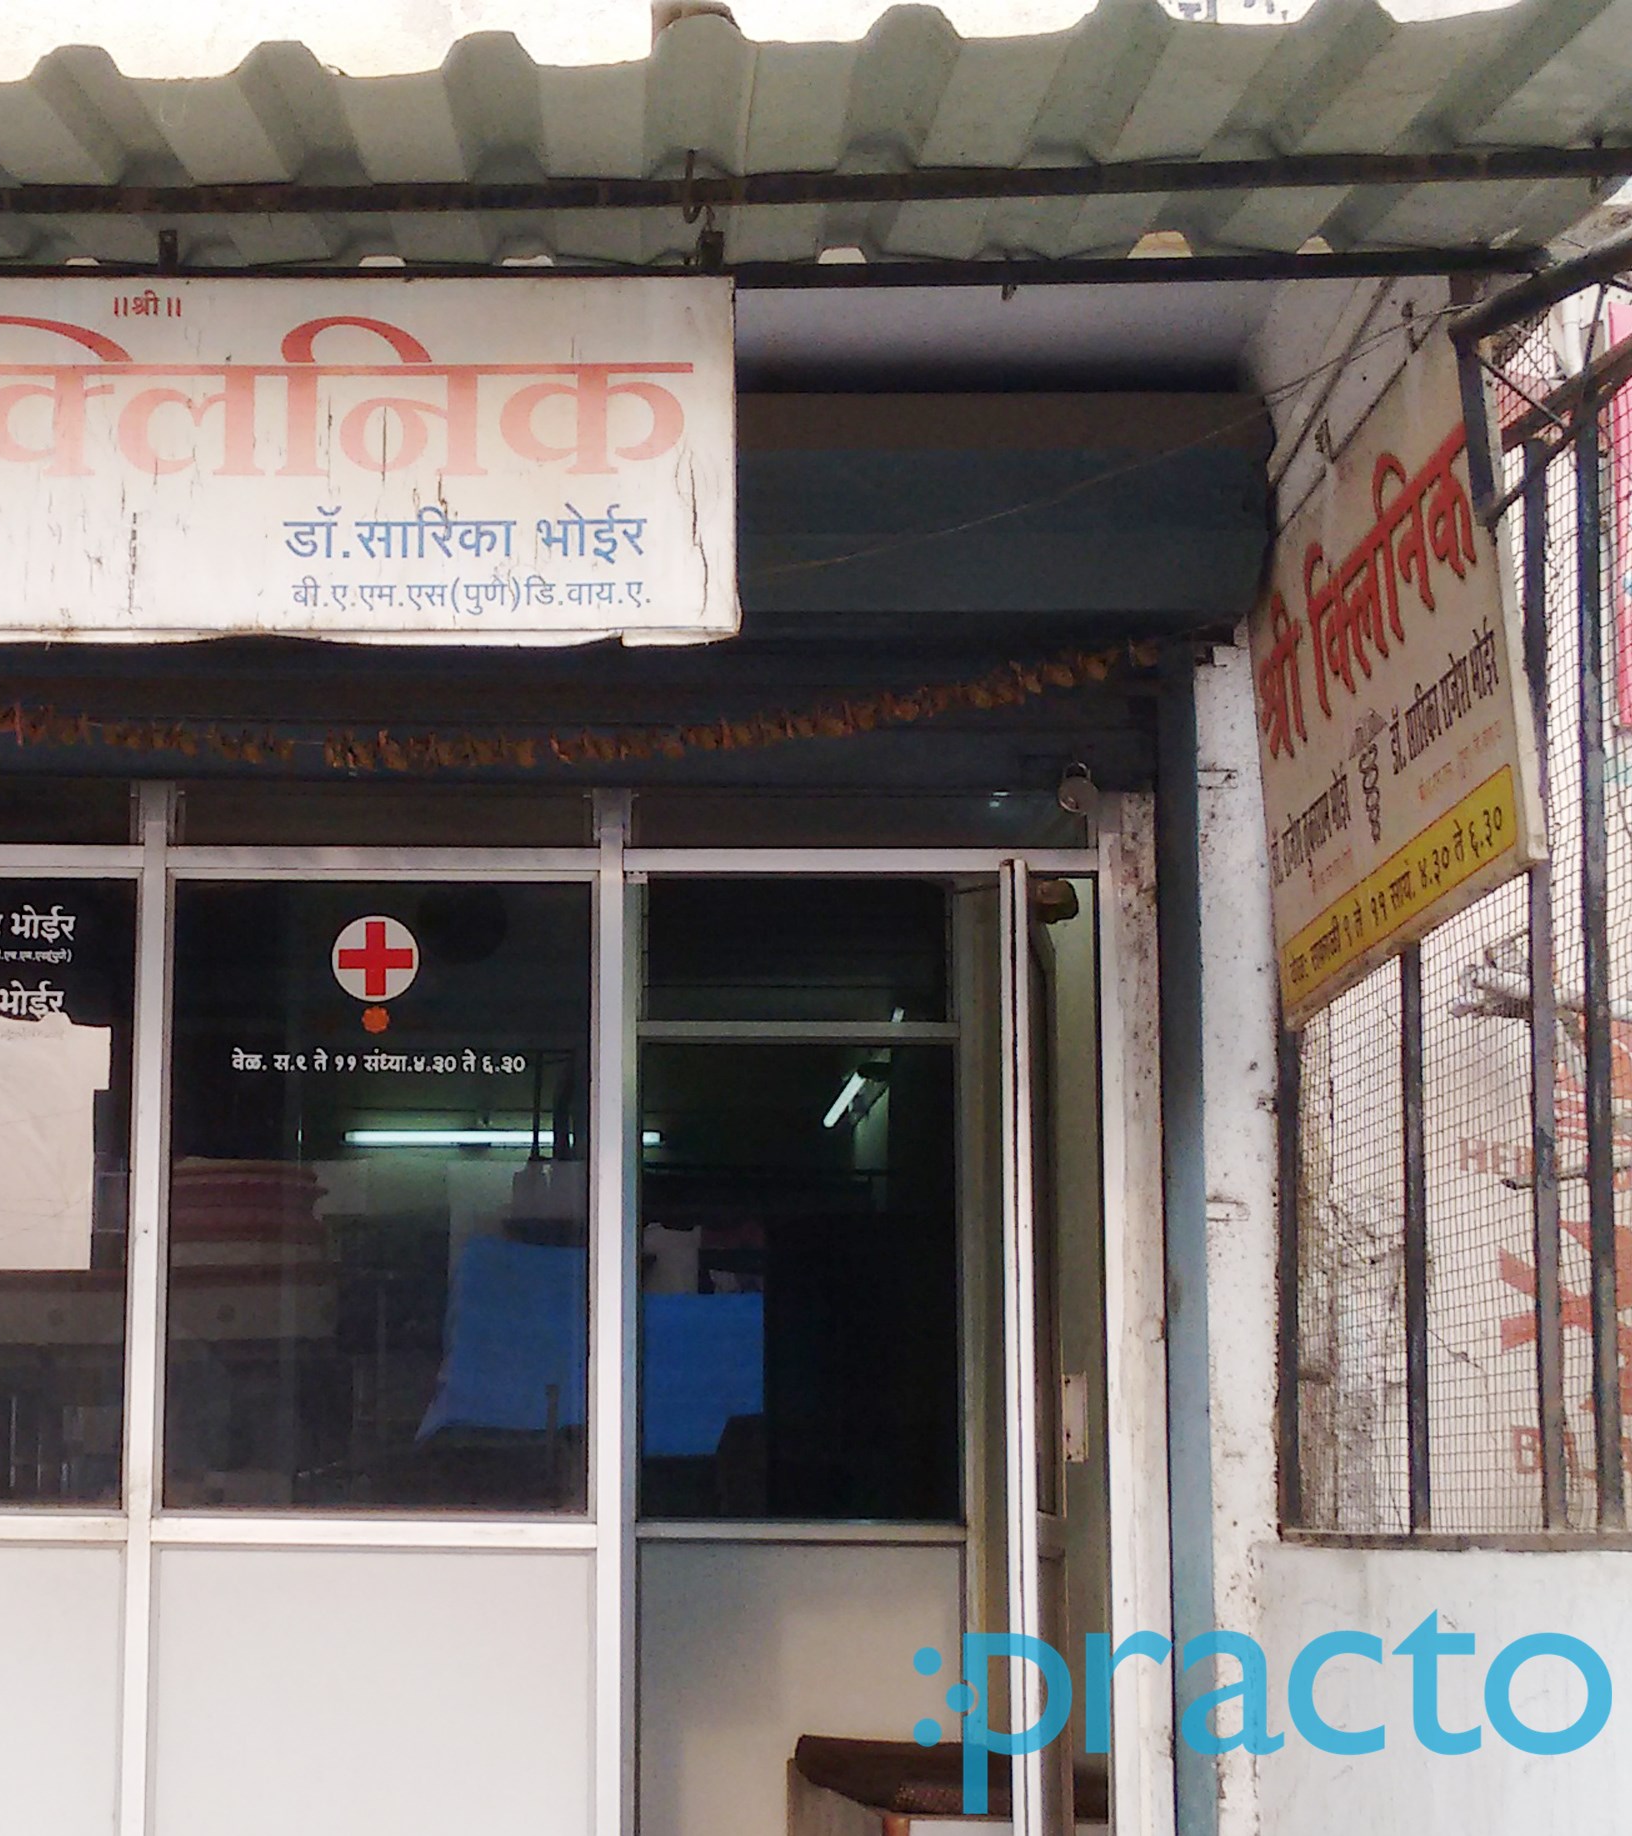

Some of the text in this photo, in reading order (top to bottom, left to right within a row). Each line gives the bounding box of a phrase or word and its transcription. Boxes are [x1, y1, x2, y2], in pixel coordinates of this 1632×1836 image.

[283, 503, 647, 565] डॉ.सारिका भोईर
[1259, 418, 1477, 760] श्री क्लिनिक
[1417, 845, 1451, 889] ४.३०
[1452, 818, 1465, 862] ते
[1469, 805, 1503, 860] ६.३०
[10, 904, 76, 941] भोईर
[314, 1048, 329, 1071] ते
[335, 1056, 357, 1071] ११
[462, 1048, 477, 1073] ते
[482, 1056, 526, 1074] ६.३०
